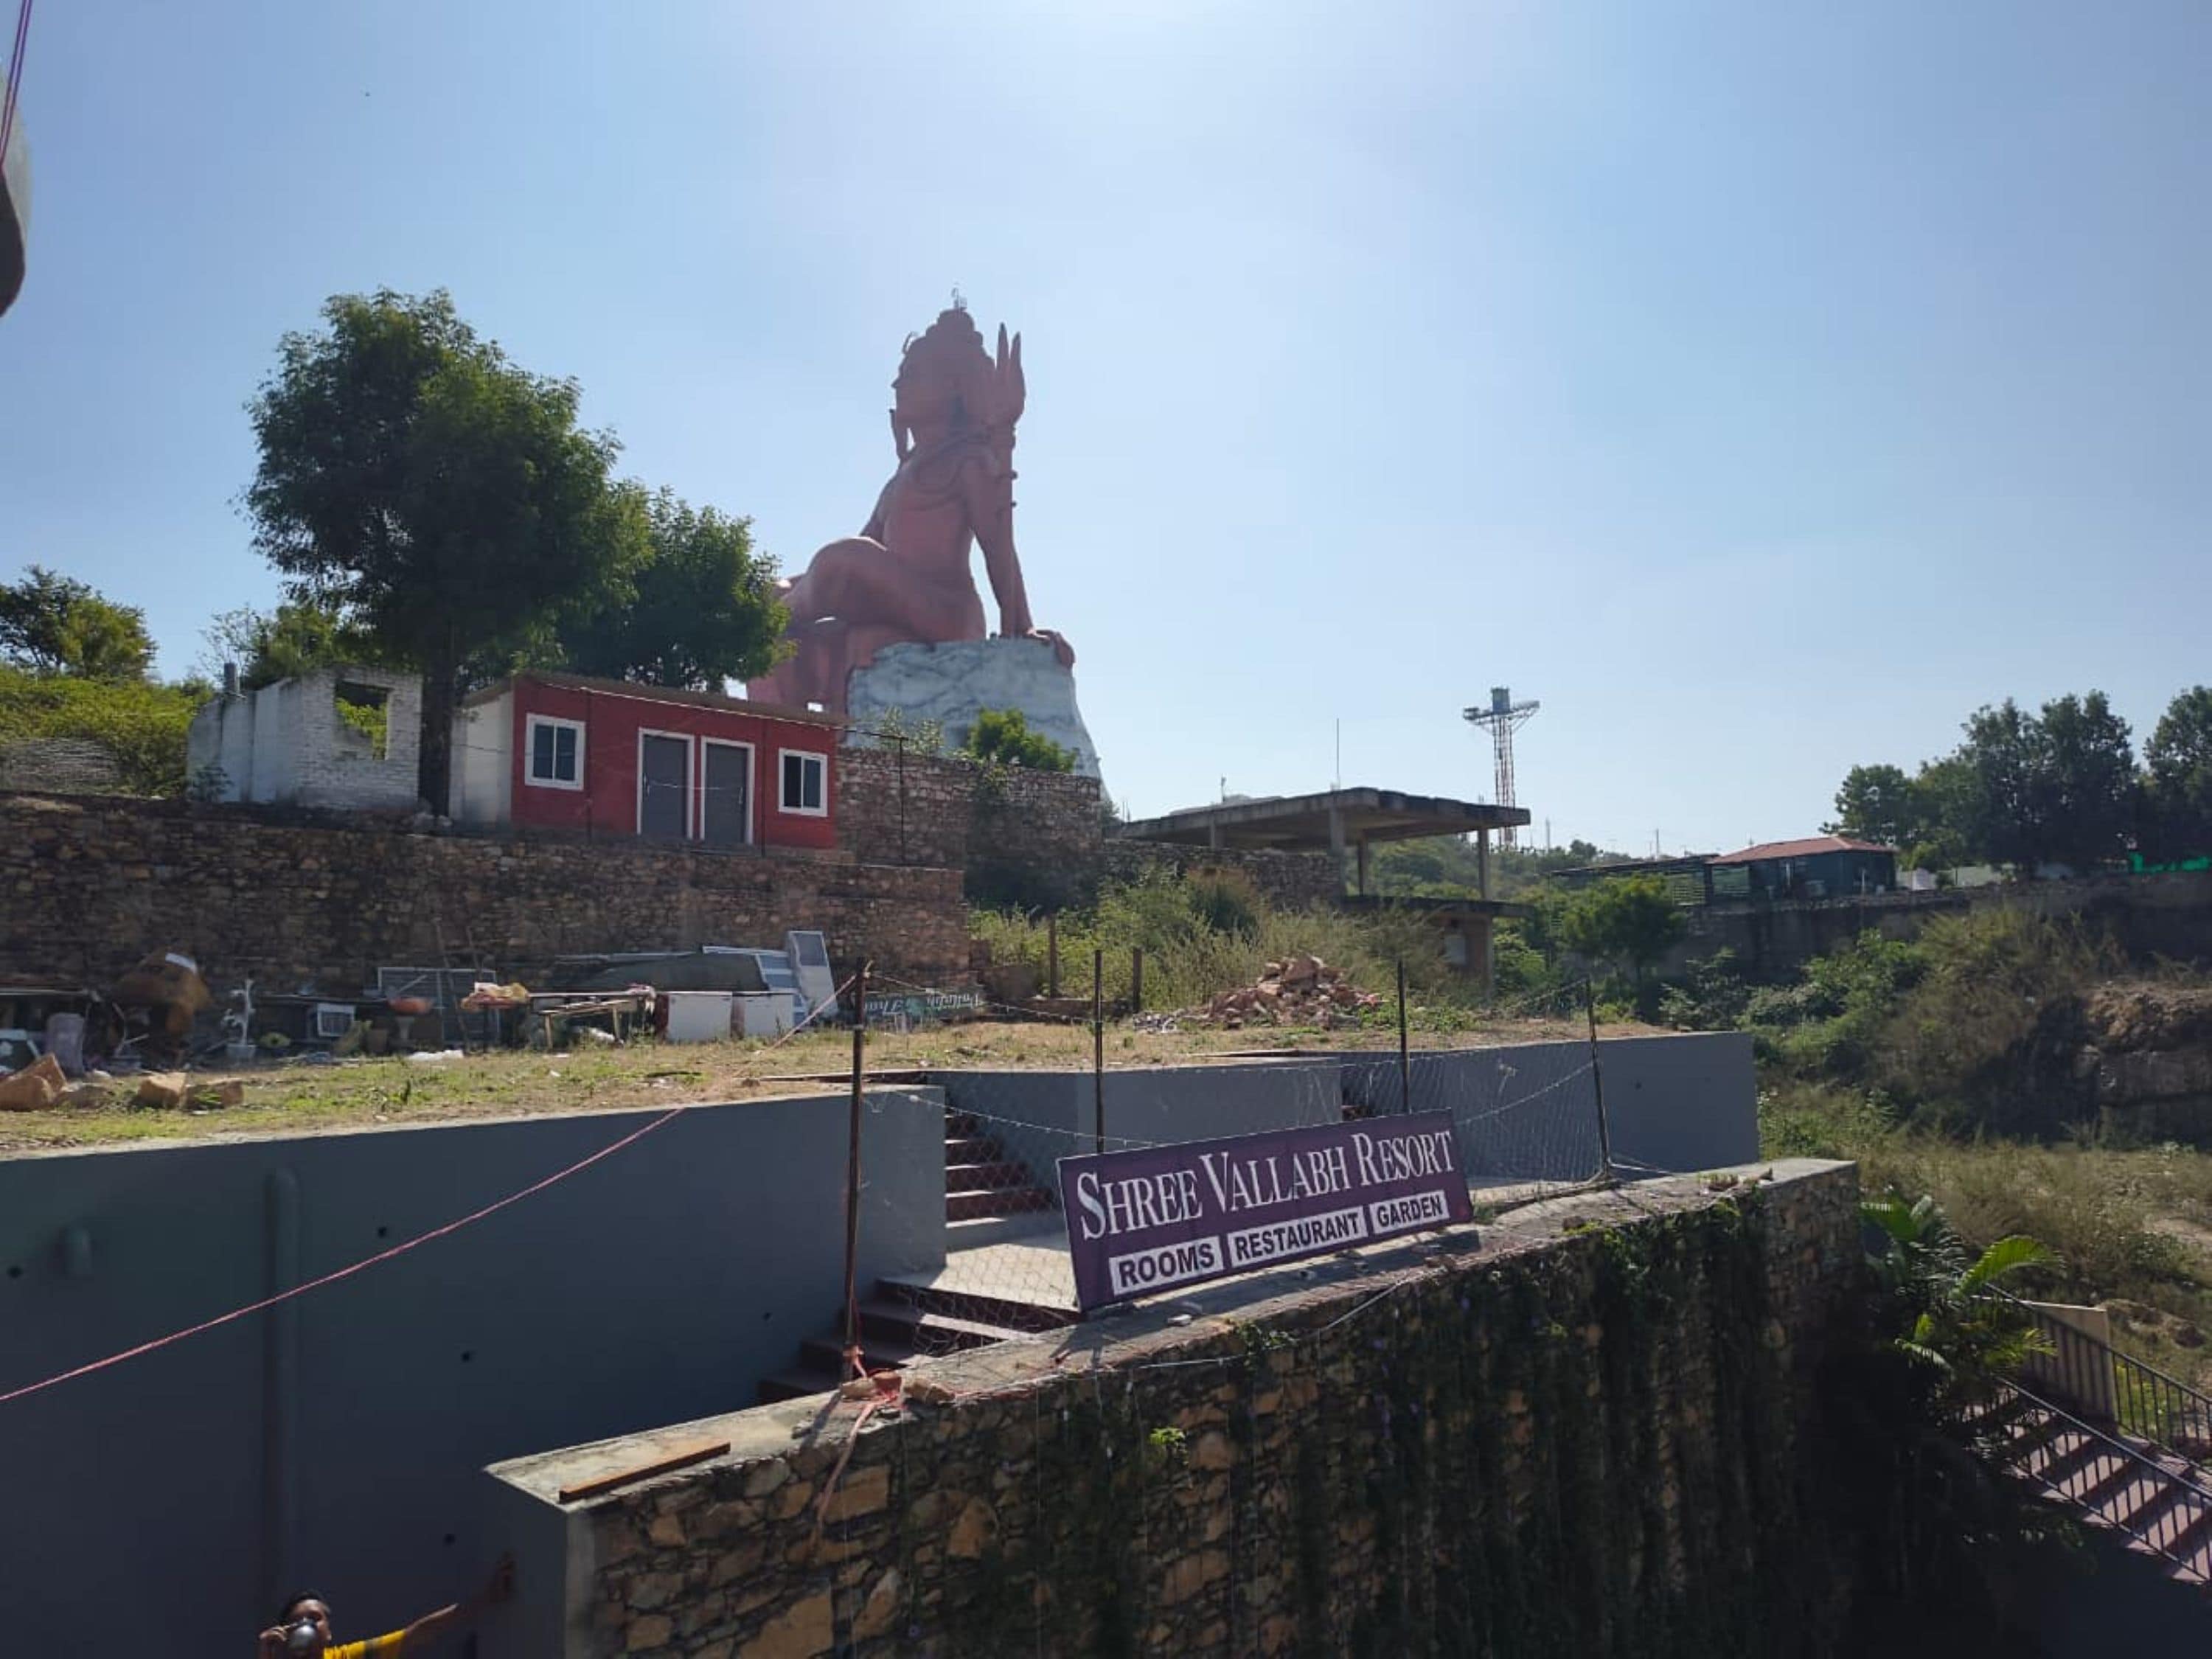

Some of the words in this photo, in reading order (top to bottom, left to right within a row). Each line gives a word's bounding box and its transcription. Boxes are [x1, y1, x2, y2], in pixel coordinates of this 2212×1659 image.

[1077, 1171, 1203, 1241] SHREE
[1200, 1147, 1350, 1213] VALLABH
[1353, 1130, 1454, 1185] RESORT
[1119, 1245, 1215, 1288] ROOMS
[1236, 1213, 1360, 1261] RESTAURANT
[1377, 1194, 1443, 1227] GARDEN
